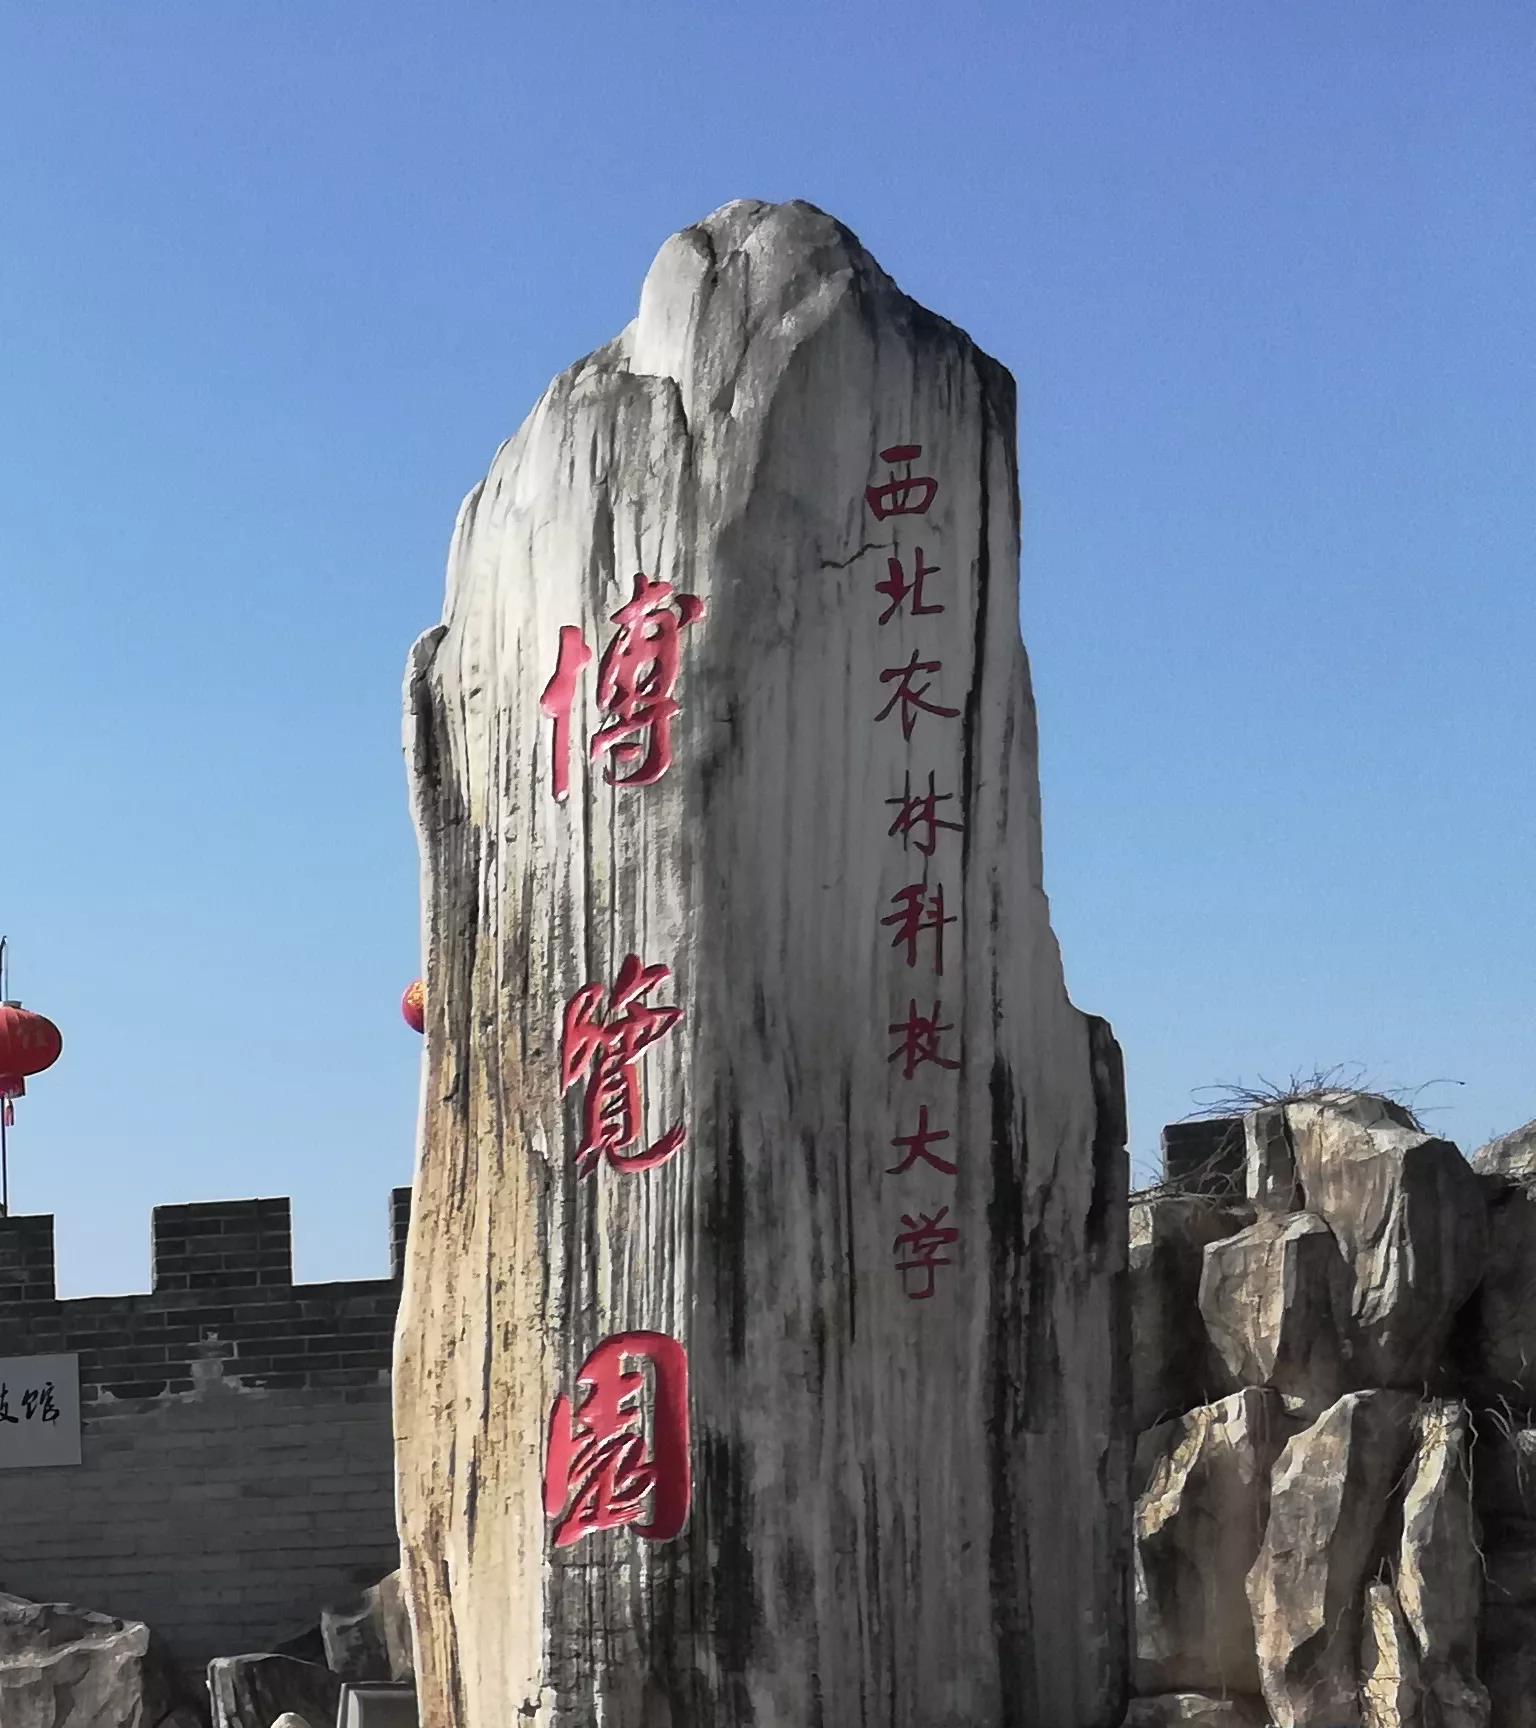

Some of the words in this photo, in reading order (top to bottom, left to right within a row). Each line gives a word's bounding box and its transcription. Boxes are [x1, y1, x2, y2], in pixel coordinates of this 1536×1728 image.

[866, 442, 964, 1299] 西北农林科技大学
